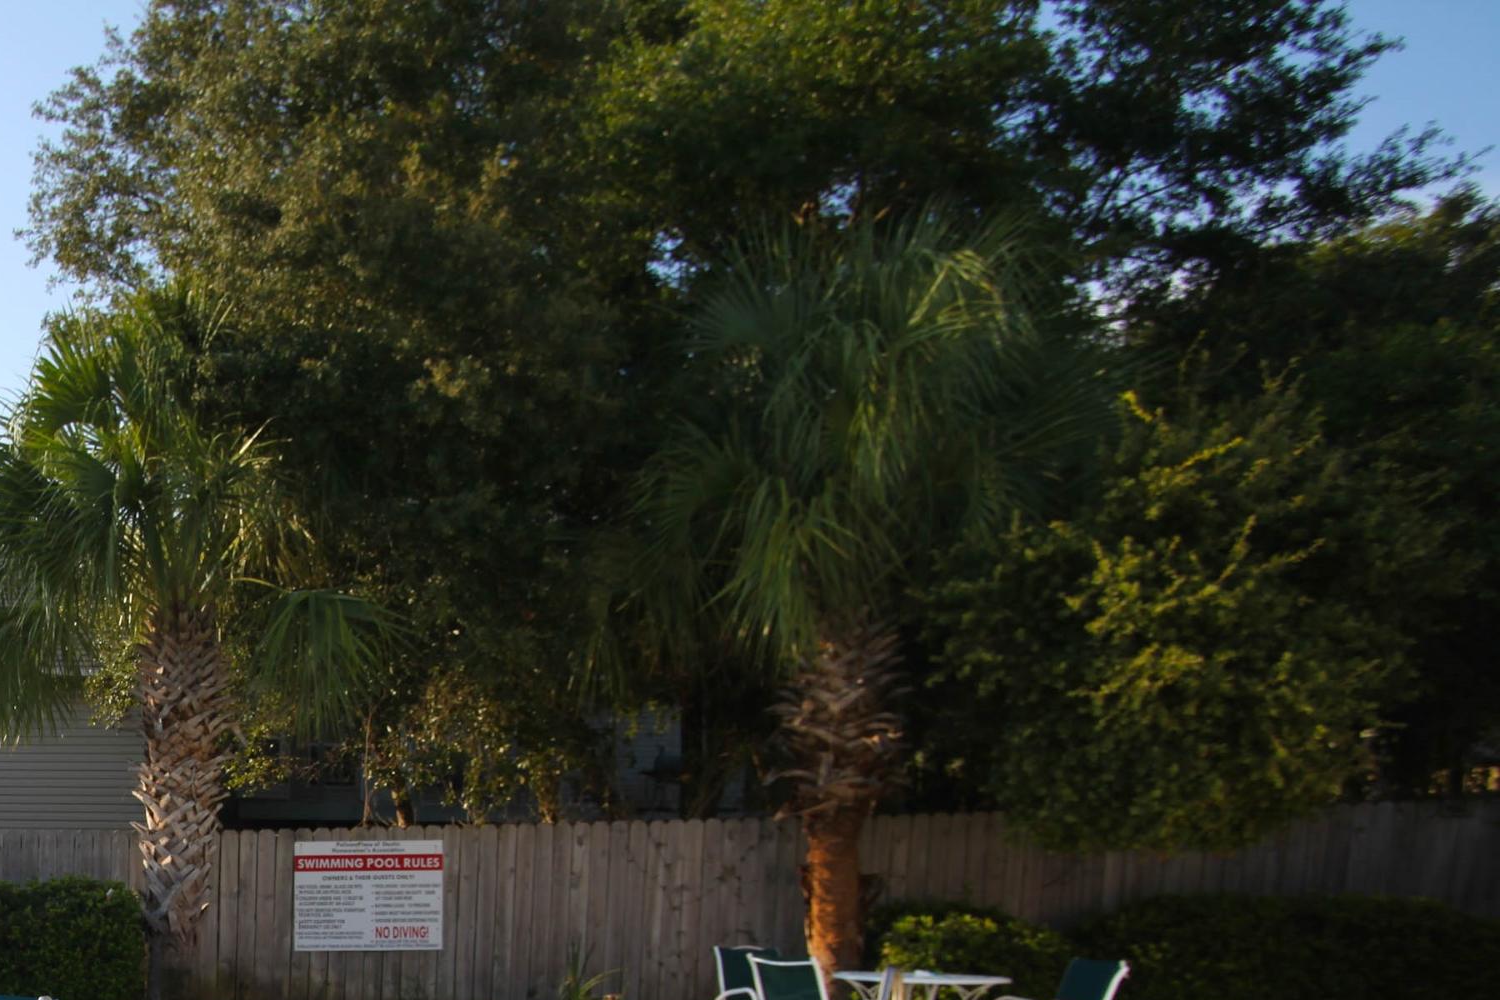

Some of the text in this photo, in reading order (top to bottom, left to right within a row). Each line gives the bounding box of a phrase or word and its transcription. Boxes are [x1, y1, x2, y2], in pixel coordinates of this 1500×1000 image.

[298, 857, 440, 869] SWIMMING POOL RULES
[375, 927, 391, 939] NO
